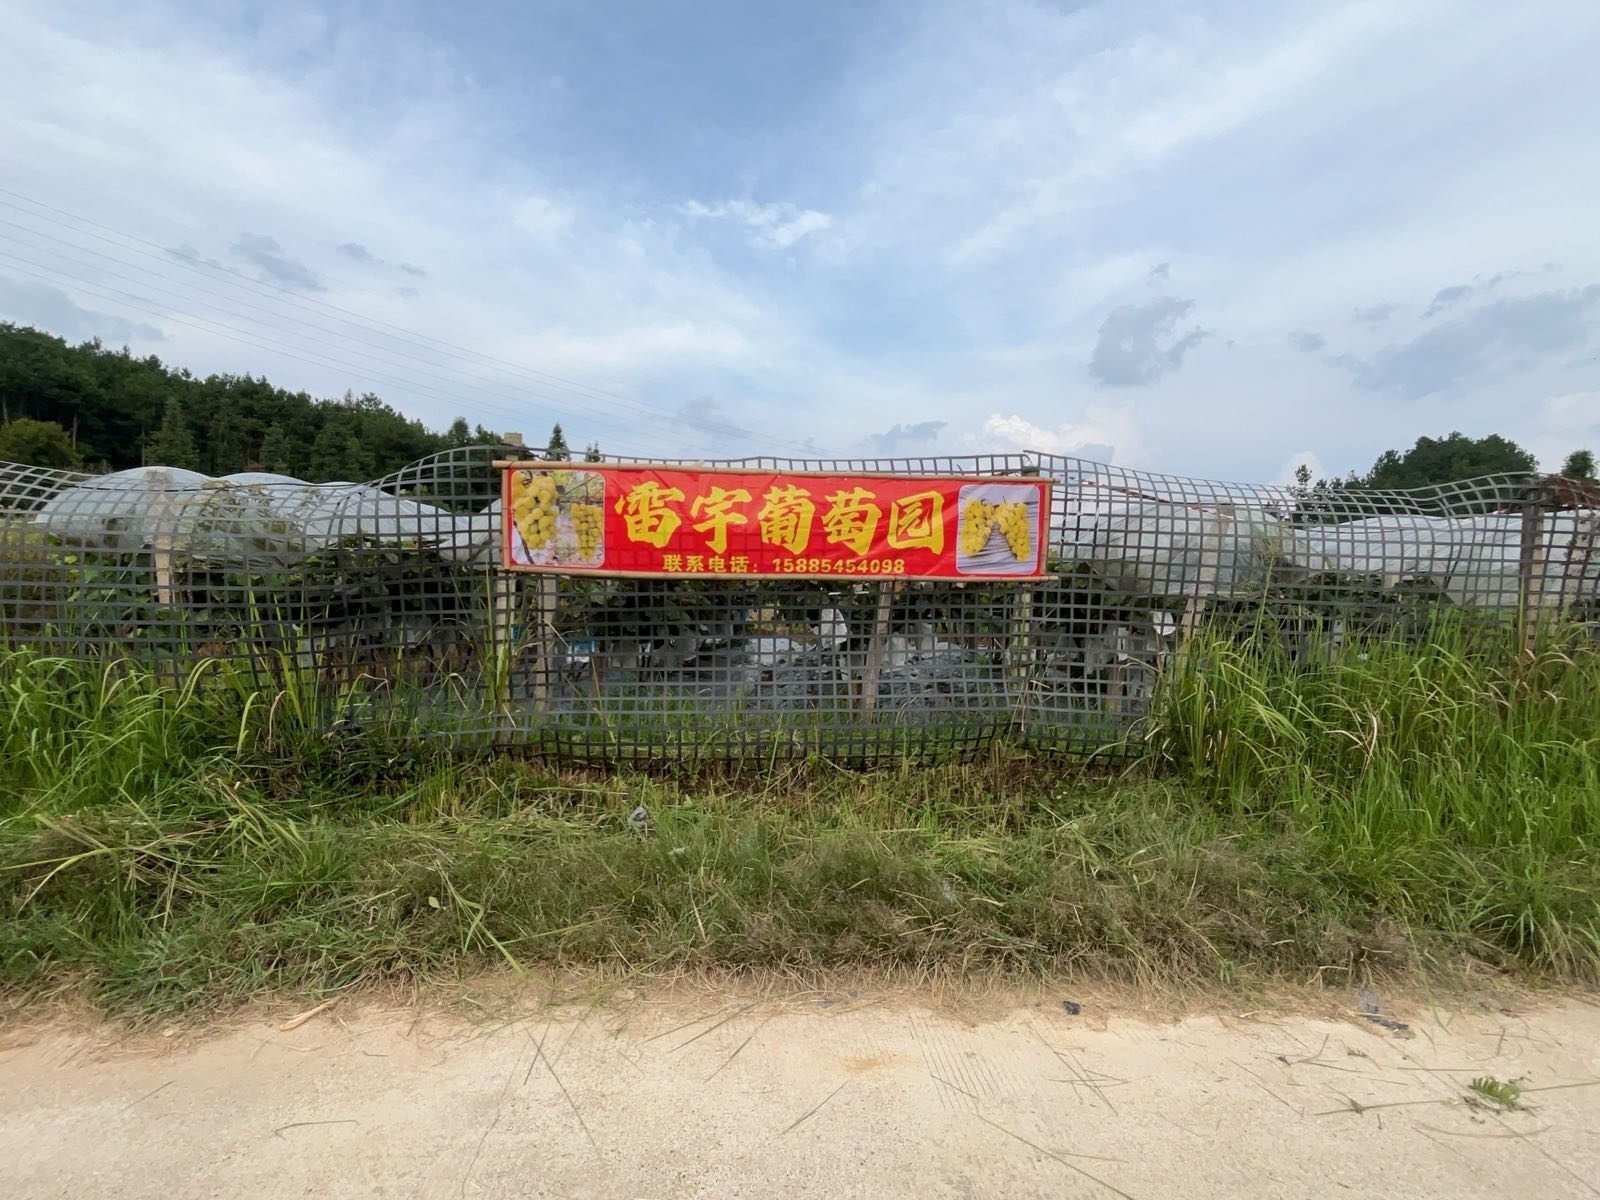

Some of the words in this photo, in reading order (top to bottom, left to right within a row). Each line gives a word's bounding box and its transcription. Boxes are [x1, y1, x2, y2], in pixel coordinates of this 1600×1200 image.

[614, 480, 945, 556] 雷宇葡萄园
[772, 558, 905, 574] 15885454098
